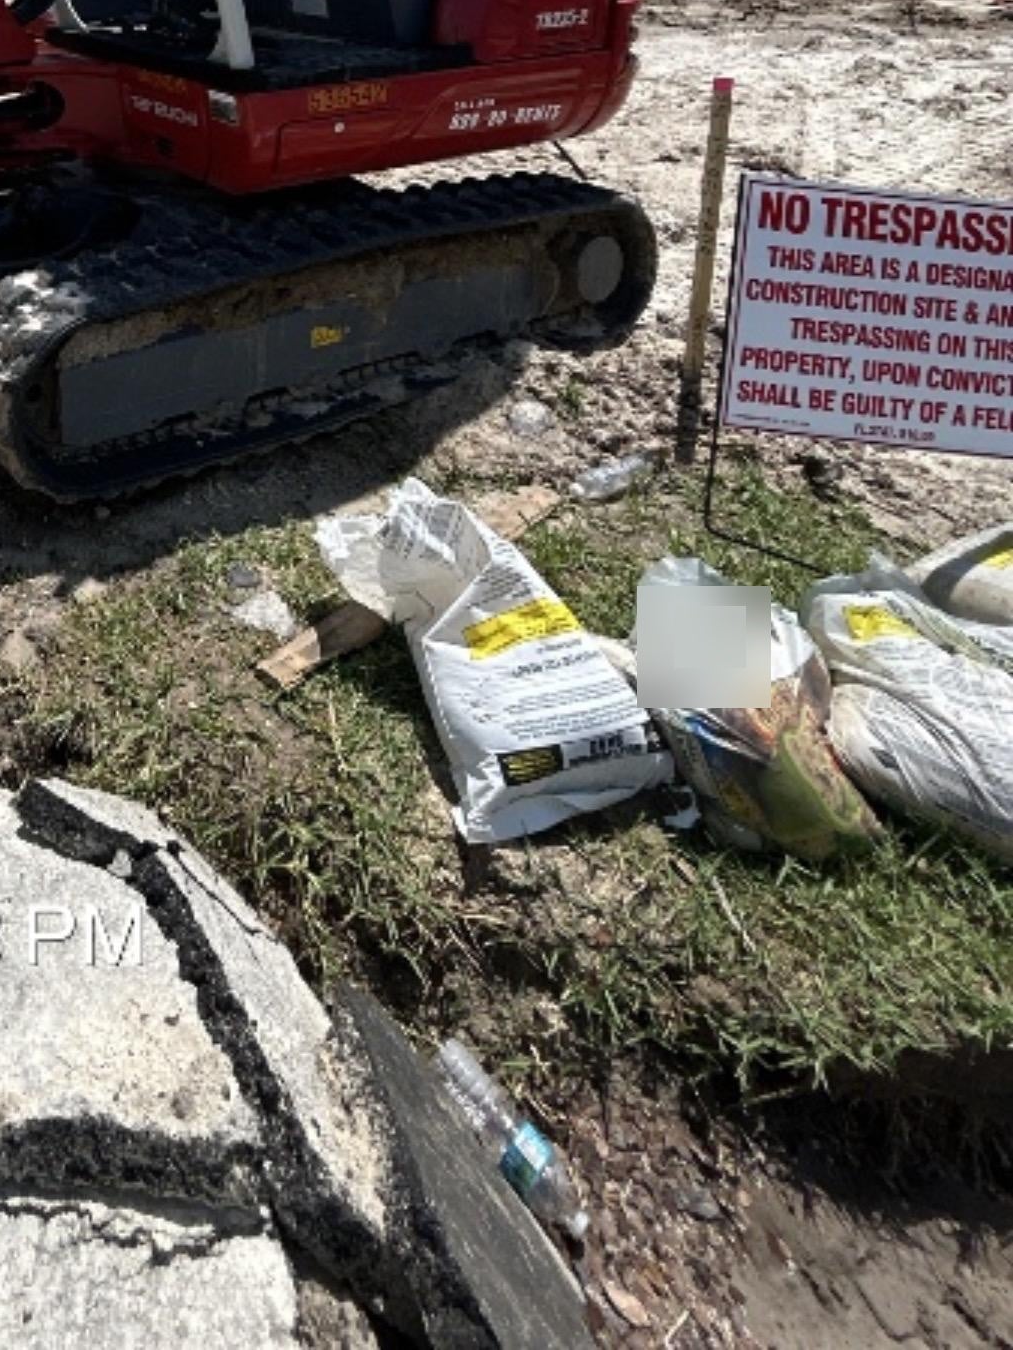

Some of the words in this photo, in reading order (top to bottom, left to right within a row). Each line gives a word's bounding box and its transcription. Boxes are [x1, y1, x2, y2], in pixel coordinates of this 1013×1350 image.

[758, 192, 810, 234] NO
[768, 246, 814, 270] THIS
[819, 251, 875, 279] AREA
[881, 262, 900, 279] IS
[906, 261, 920, 283] A
[927, 263, 1013, 292] DESIGNA
[747, 279, 906, 316] CONSTRUCTION
[914, 296, 957, 322] SITE
[964, 301, 979, 324] &
[791, 318, 930, 353] TRESPASSING
[939, 336, 966, 358] ON
[740, 347, 855, 384] PROPERTY,
[863, 360, 920, 387] UPON
[737, 381, 800, 408] SHALL
[809, 390, 834, 411] BE
[842, 392, 914, 421] GUILTY
[920, 402, 947, 424] OF
[952, 405, 966, 426] A
[972, 407, 1013, 432] FEL
